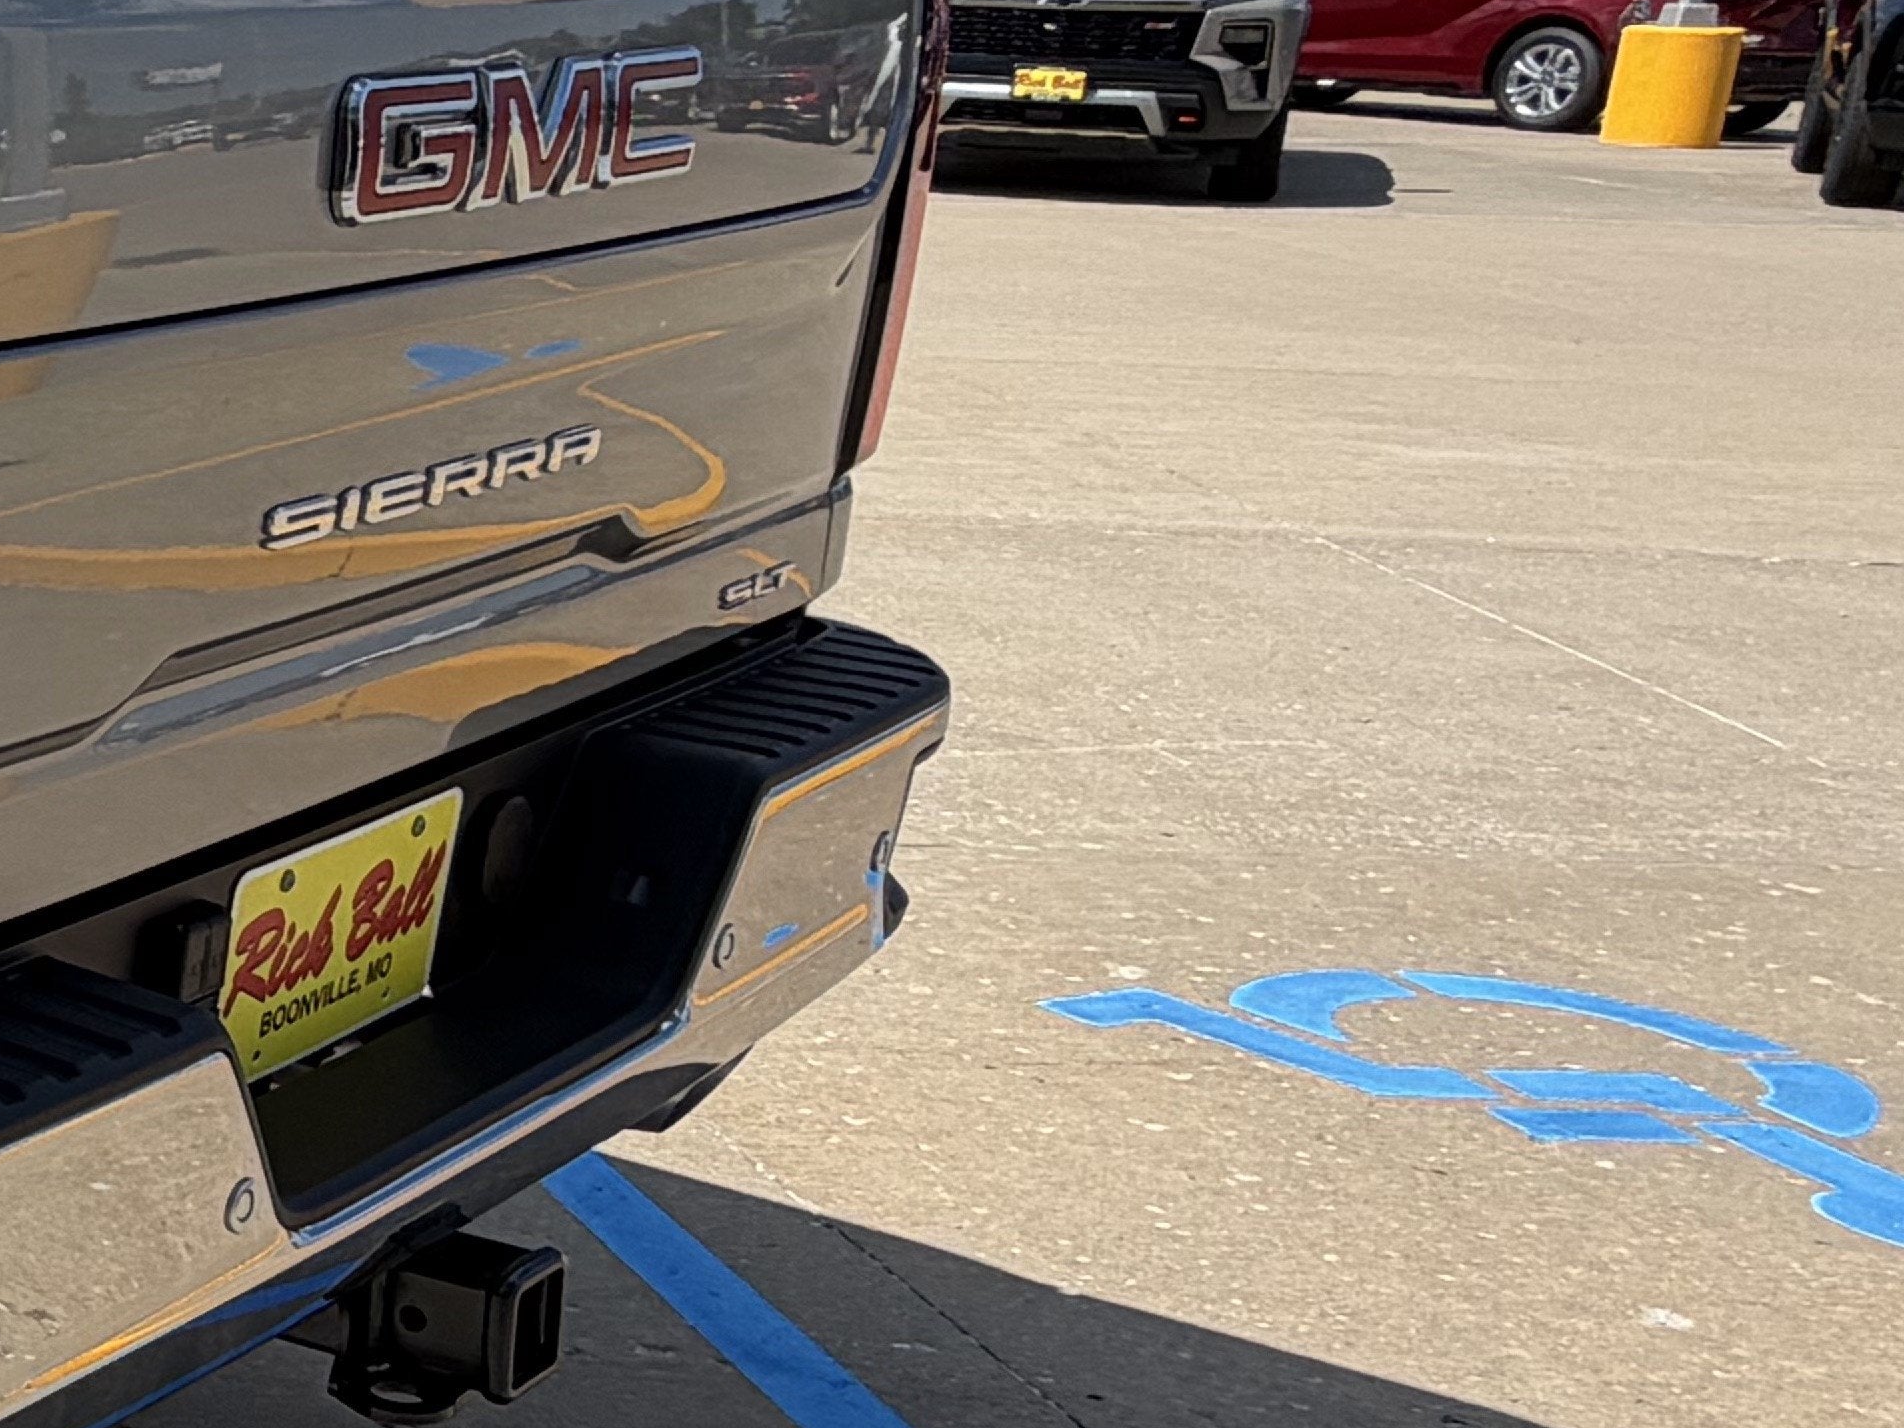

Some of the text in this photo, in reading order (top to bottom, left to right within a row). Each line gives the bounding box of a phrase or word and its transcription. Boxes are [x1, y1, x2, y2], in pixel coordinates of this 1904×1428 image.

[330, 44, 703, 226] GMC
[262, 423, 602, 551] SIERRA
[718, 560, 798, 610] SLT
[222, 839, 447, 1019] Rick Ball
[258, 952, 393, 1039] BOONVILLE, MO
